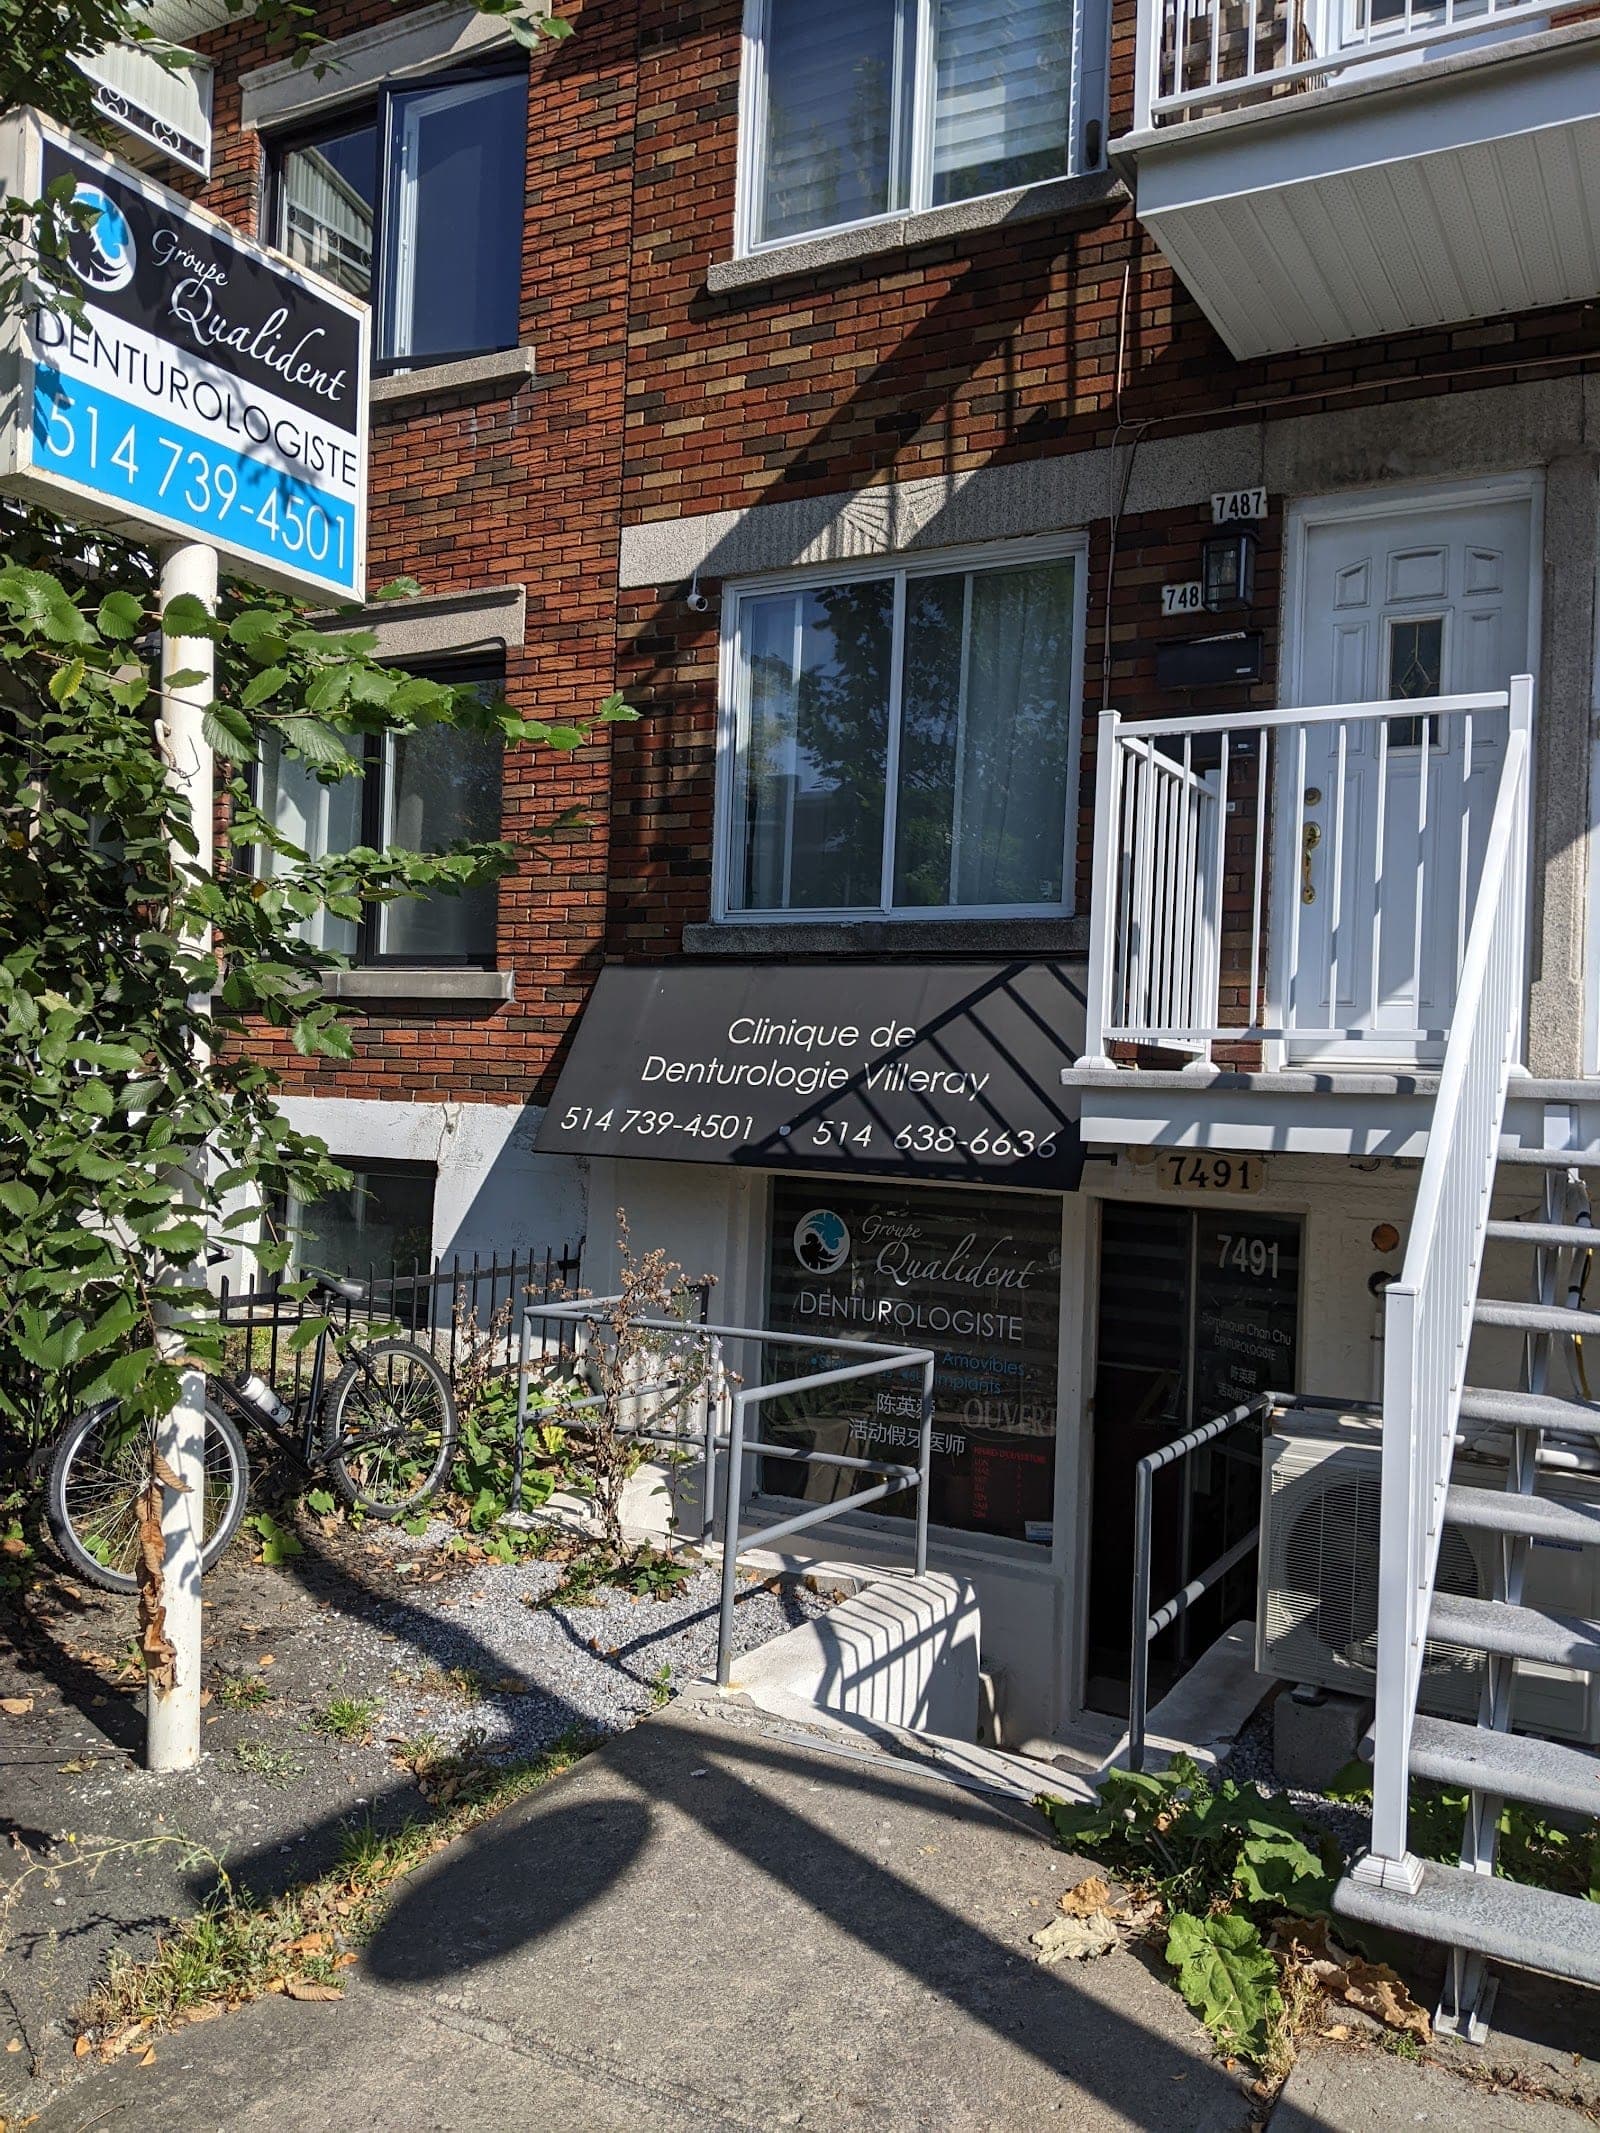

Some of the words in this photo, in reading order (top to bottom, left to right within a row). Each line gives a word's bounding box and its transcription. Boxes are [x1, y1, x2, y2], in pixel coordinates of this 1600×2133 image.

[151, 228, 229, 288] Groupe
[168, 277, 347, 402] Qualident
[35, 304, 358, 488] DENTUROLOGISTE
[47, 392, 140, 484] 514
[158, 437, 346, 570] 739-4501
[1216, 491, 1262, 519] 7487
[1167, 586, 1200, 611] 748
[727, 1016, 860, 1053] Clinique
[870, 1019, 918, 1049] de
[640, 1055, 849, 1096] Denturologie
[863, 1062, 990, 1102] Villeray
[560, 1106, 611, 1132] 514
[619, 1109, 754, 1141] 739-4501
[812, 1120, 873, 1148] 514
[893, 1122, 1058, 1159] 638-6636
[1168, 1156, 1250, 1190] 7491
[861, 1215, 922, 1248] Groupe
[874, 1232, 1038, 1290] Qualident
[1216, 1234, 1279, 1279] 7491
[800, 1291, 1023, 1341] DENTUROLOGISTE
[1272, 1329, 1292, 1346] Chu
[942, 1350, 1025, 1377] Amovibles
